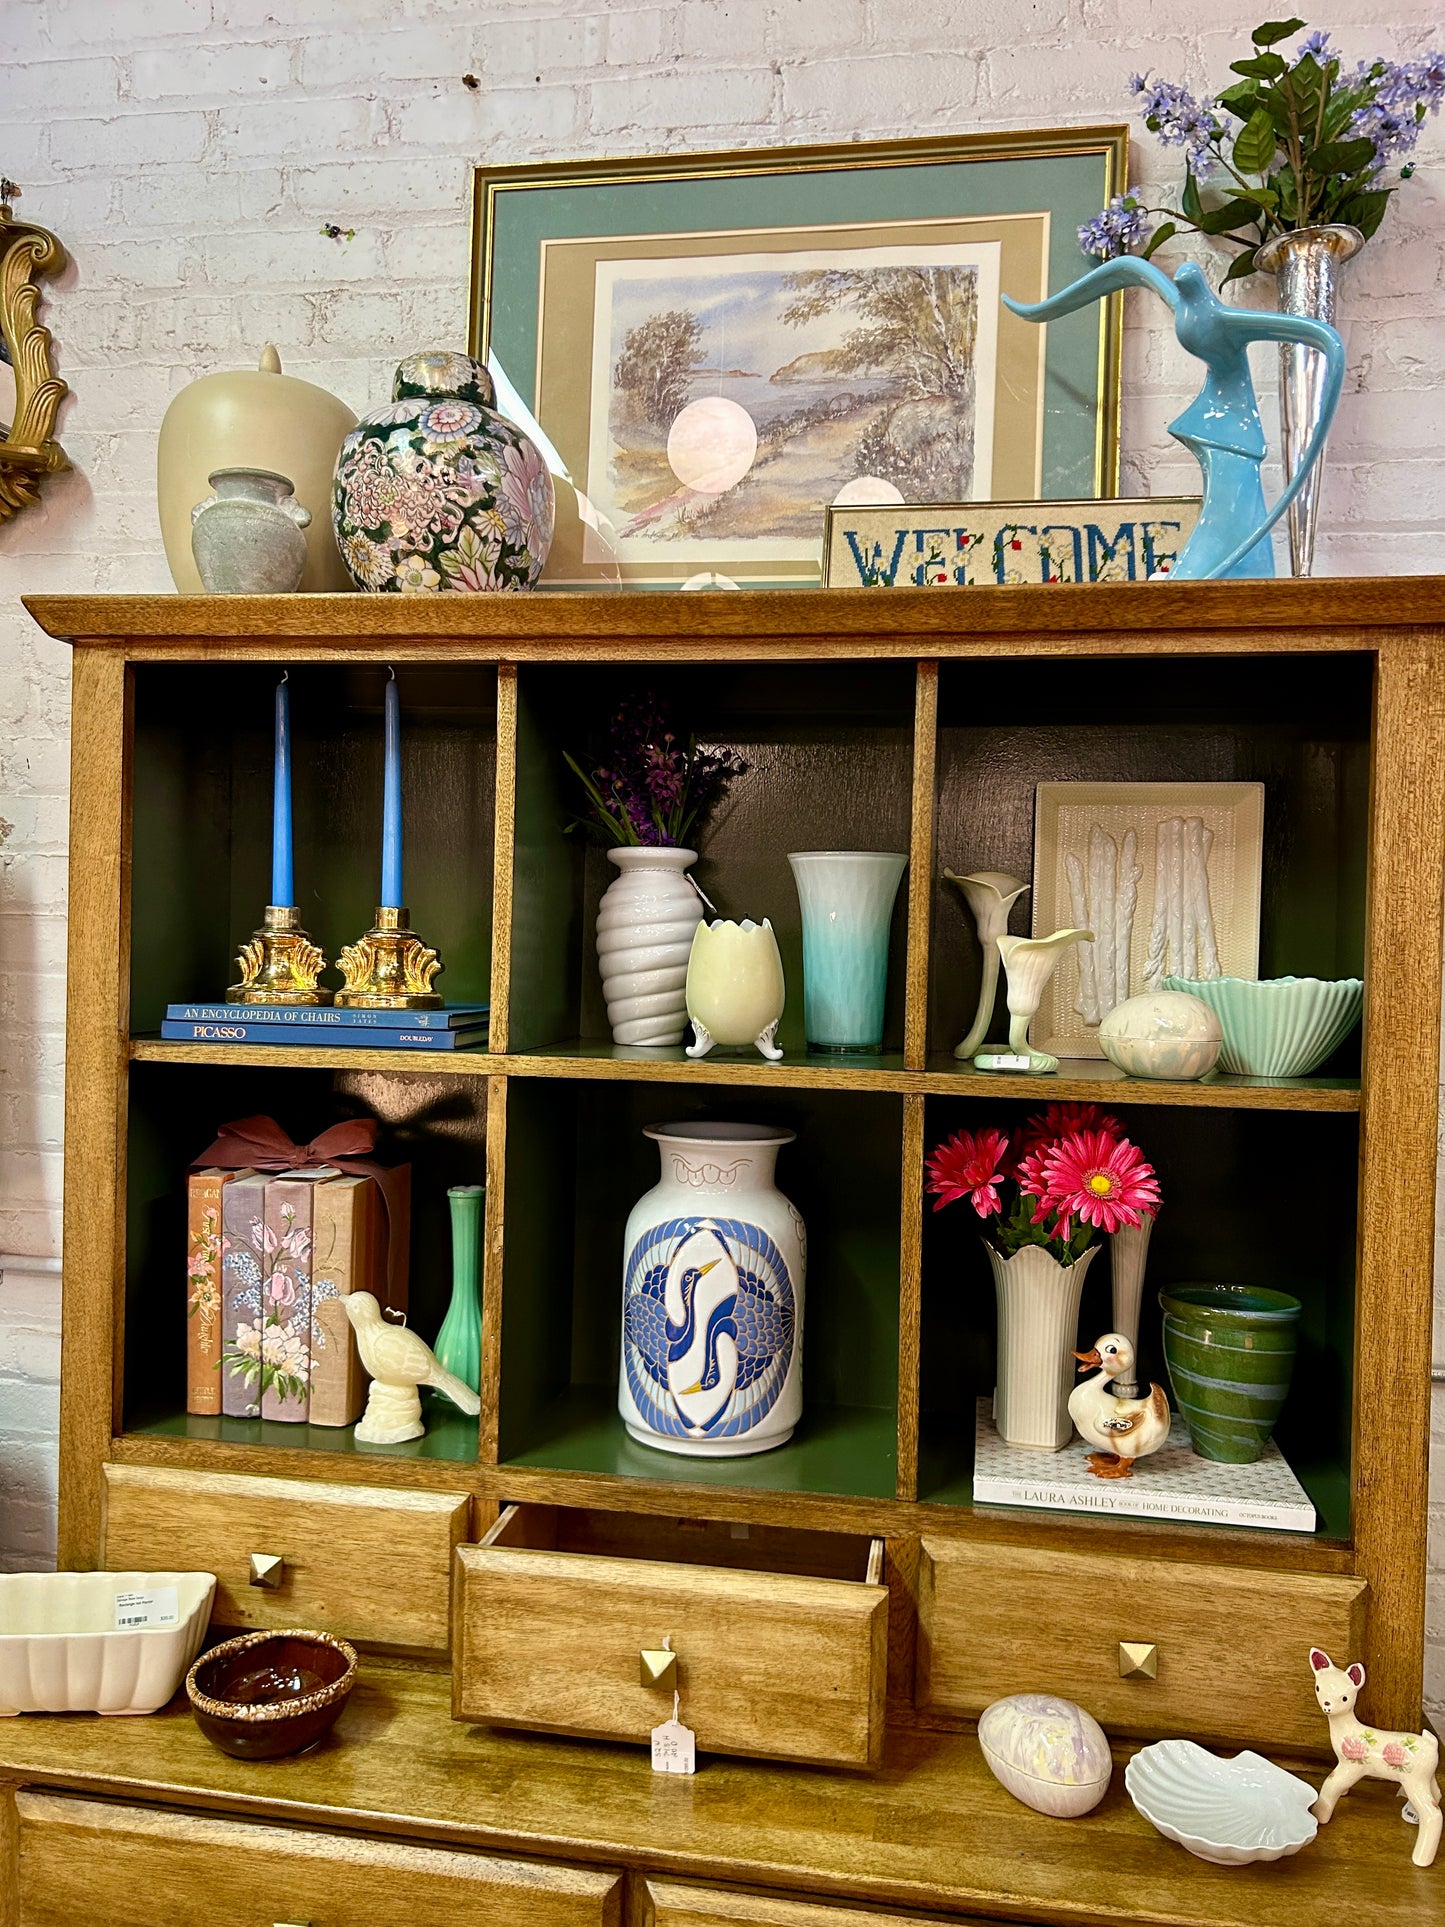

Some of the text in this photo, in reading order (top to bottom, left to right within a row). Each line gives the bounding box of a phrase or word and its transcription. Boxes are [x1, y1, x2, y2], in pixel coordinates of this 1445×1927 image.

[843, 521, 1181, 586] WELCOME
[184, 1008, 341, 1023] AN ENCYCLOPEDIA OF CHAIRS
[193, 1026, 246, 1039] PICASSO
[1023, 1490, 1066, 1504] LAURA
[1069, 1493, 1117, 1508] ASHLEY
[1142, 1502, 1169, 1513] HOME
[1170, 1503, 1229, 1518] DECORATING
